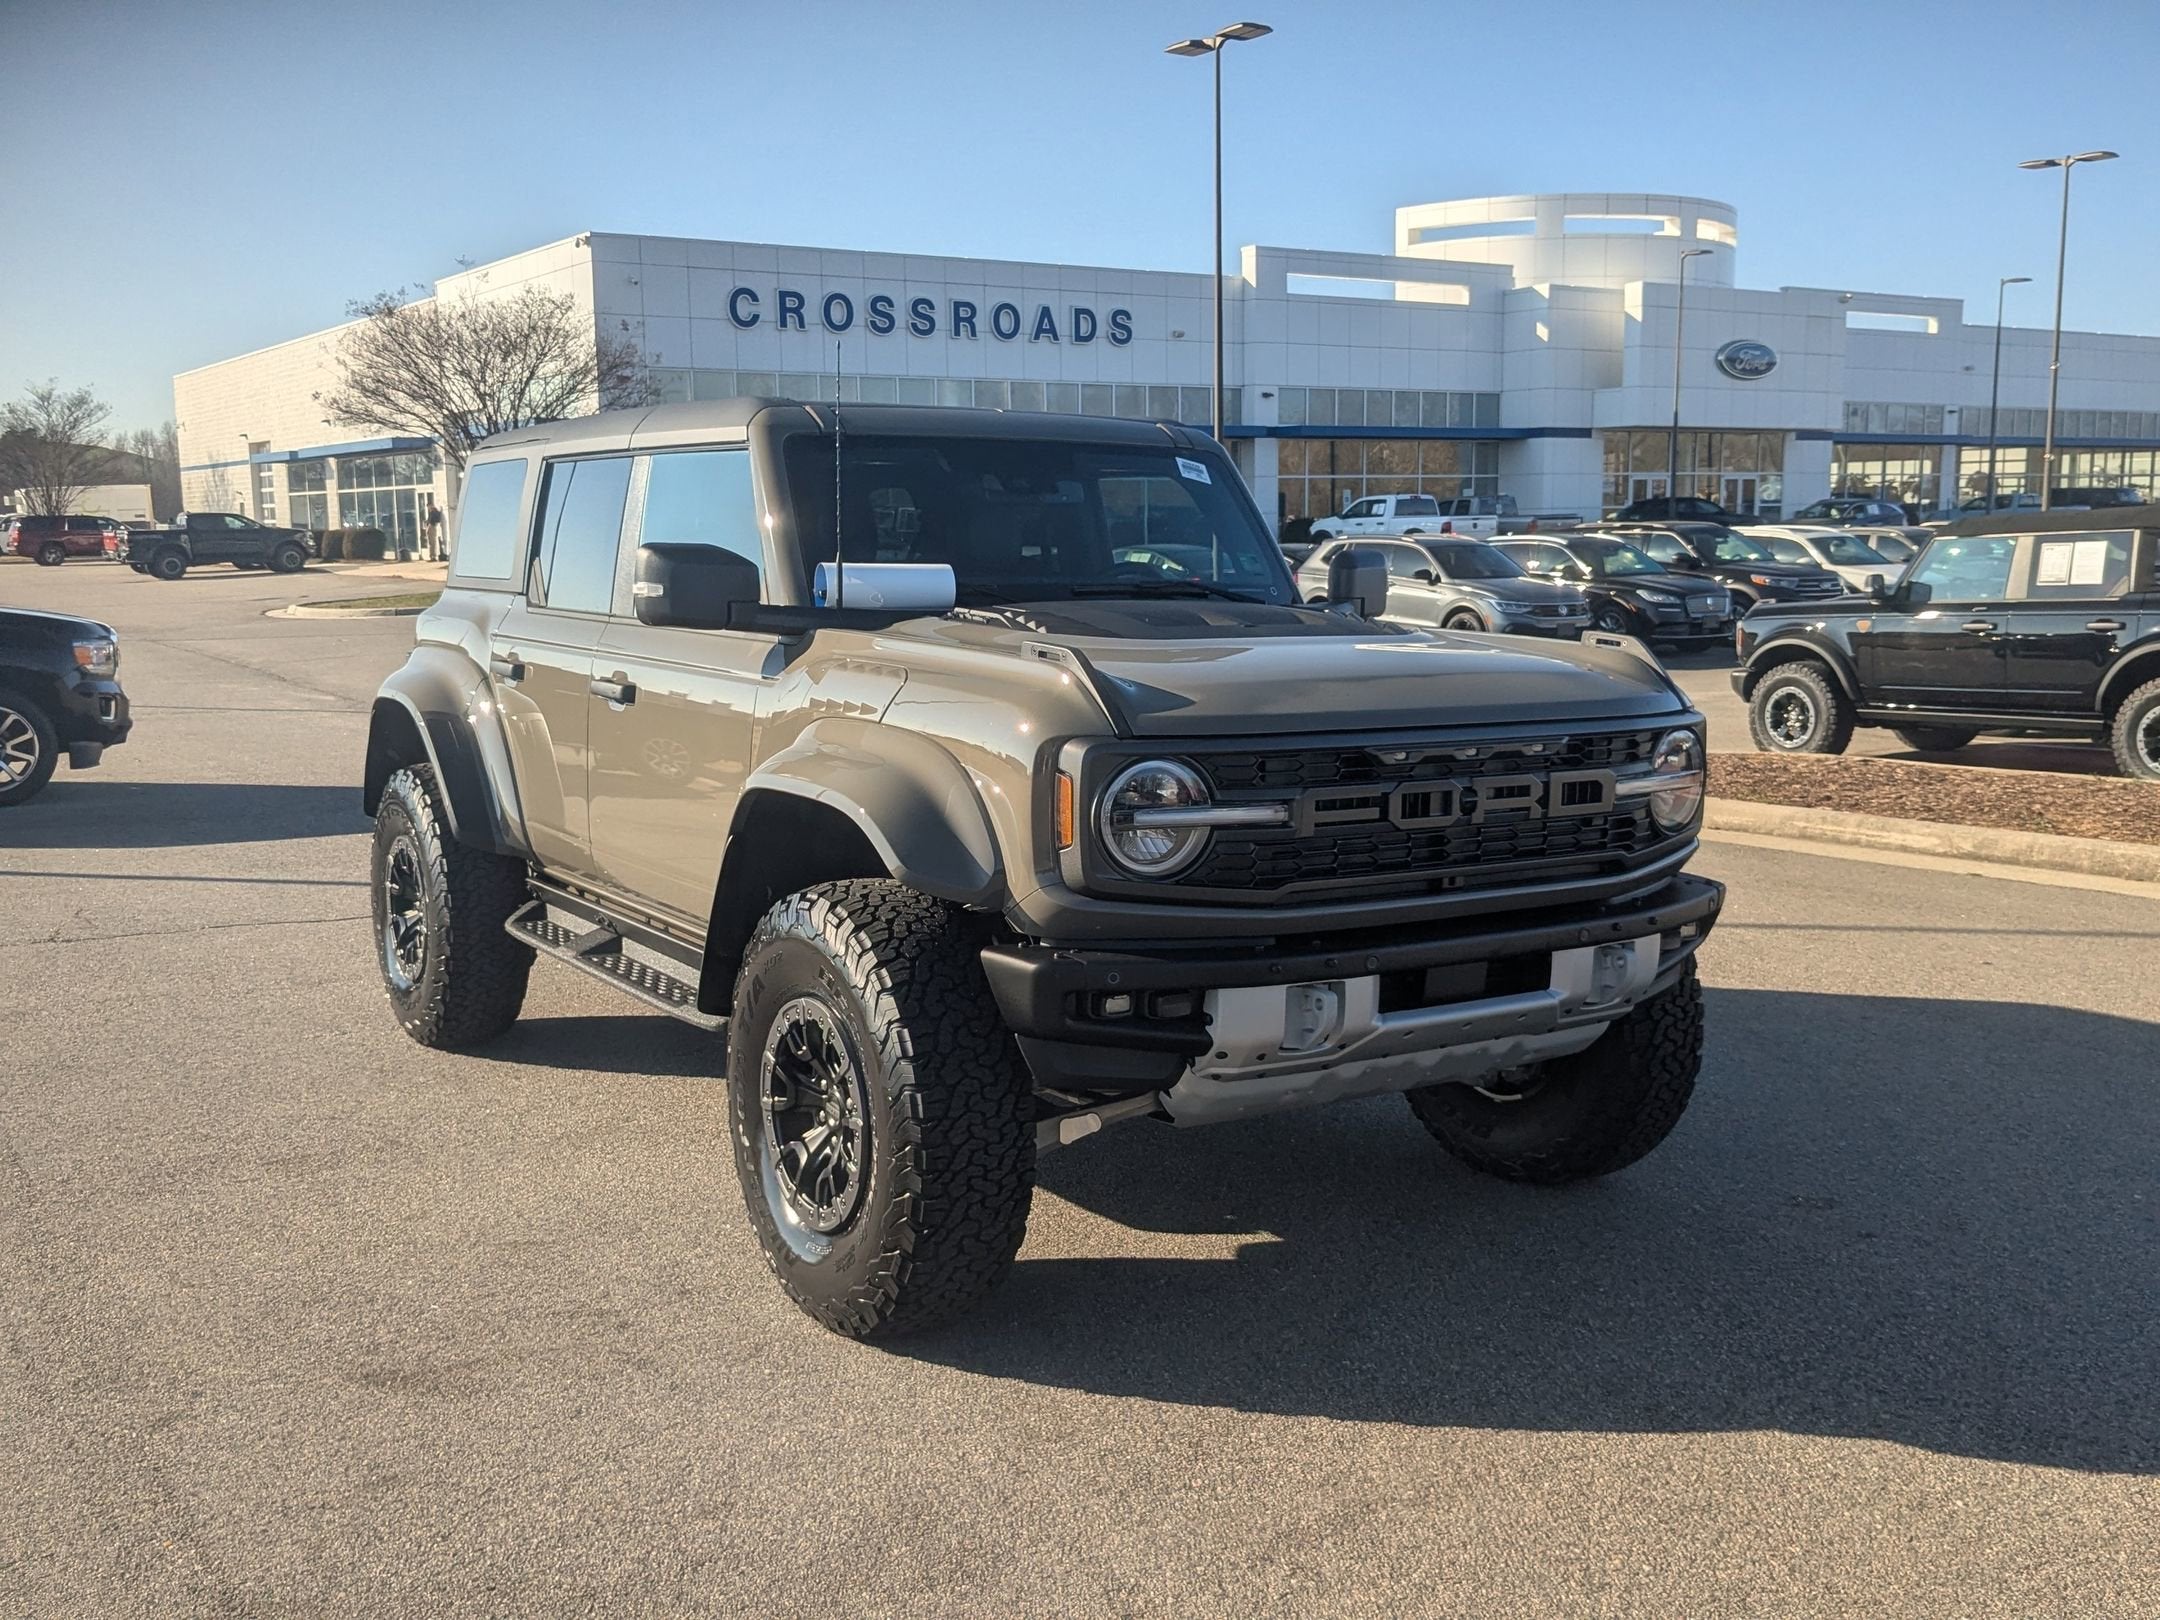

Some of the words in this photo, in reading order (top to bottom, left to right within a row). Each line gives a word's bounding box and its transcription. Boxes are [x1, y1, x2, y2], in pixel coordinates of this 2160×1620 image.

[728, 286, 1134, 347] CROSSROADS
[1735, 348, 1770, 370] Ford
[1296, 768, 1616, 837] FORD
